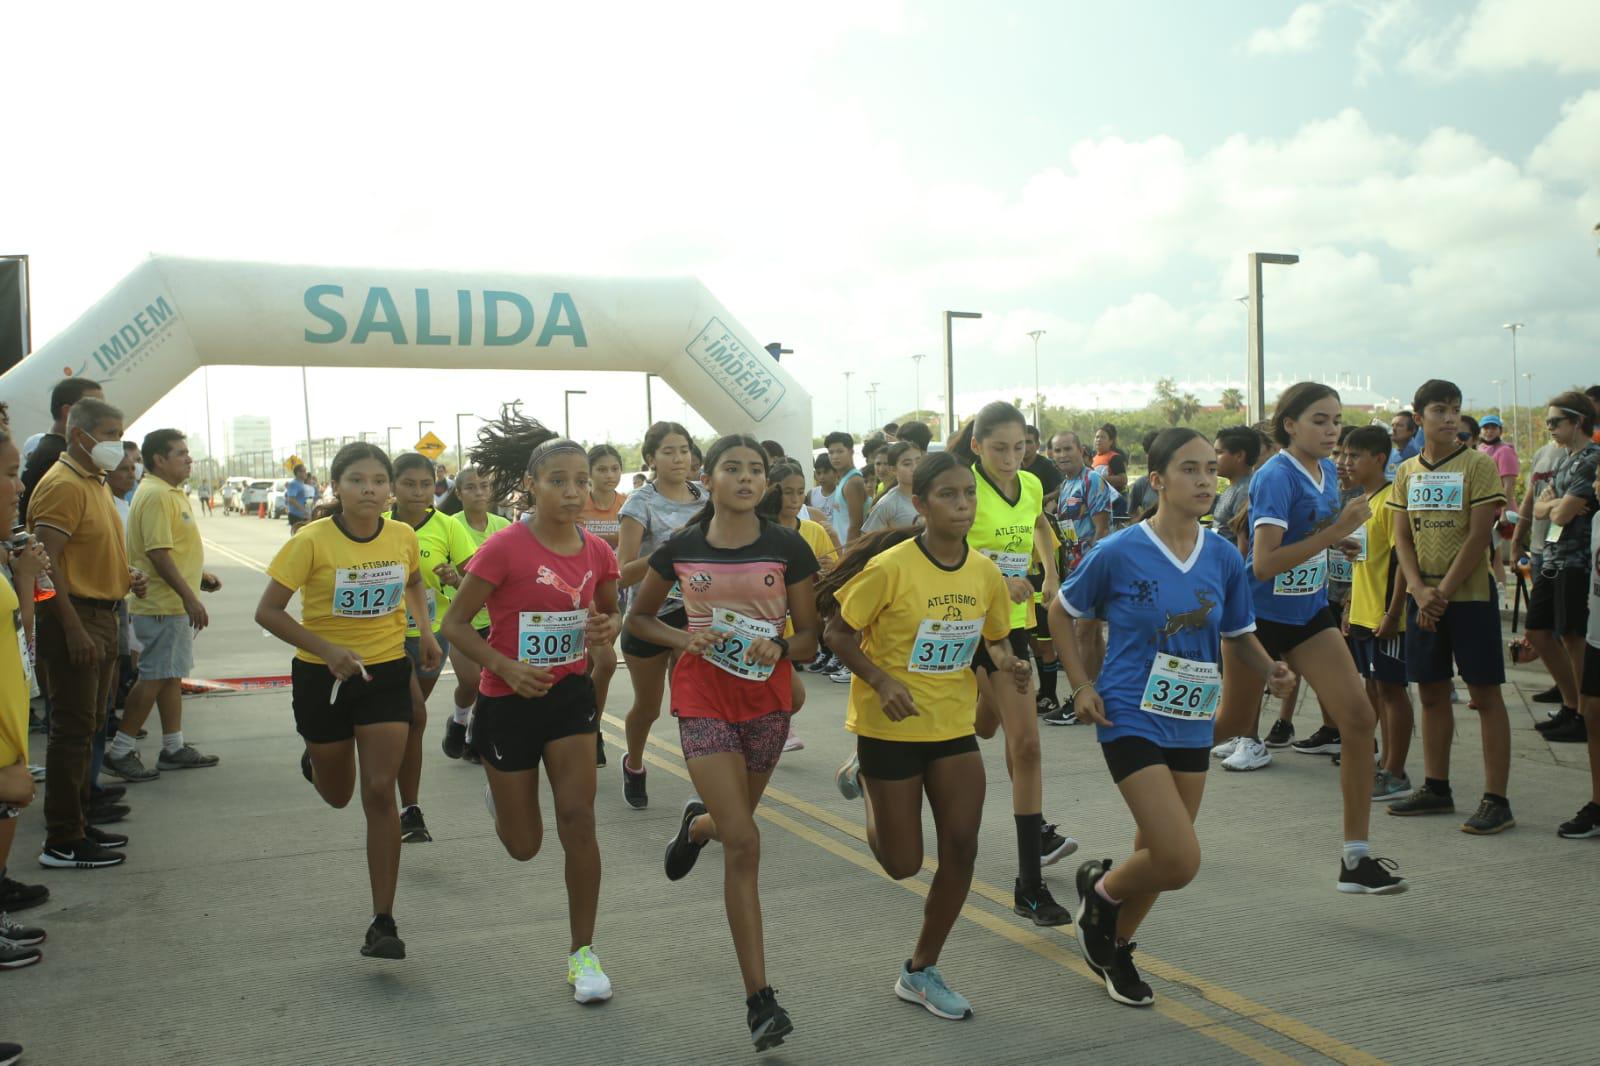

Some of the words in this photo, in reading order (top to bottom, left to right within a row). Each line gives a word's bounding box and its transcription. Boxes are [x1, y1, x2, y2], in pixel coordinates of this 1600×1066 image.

[303, 284, 588, 348] SALIDA
[92, 295, 173, 372] IMDEM
[705, 340, 768, 400] IMDEM
[721, 334, 772, 388] FUERZA
[1412, 488, 1444, 503] 303
[1424, 520, 1456, 529] Coppel
[1281, 567, 1318, 587] 327
[340, 588, 385, 608] 312
[928, 594, 977, 608] ATLETISMO
[526, 634, 571, 656] 308
[714, 637, 755, 667] 32
[918, 642, 964, 663] 317
[1152, 679, 1203, 708] 326
